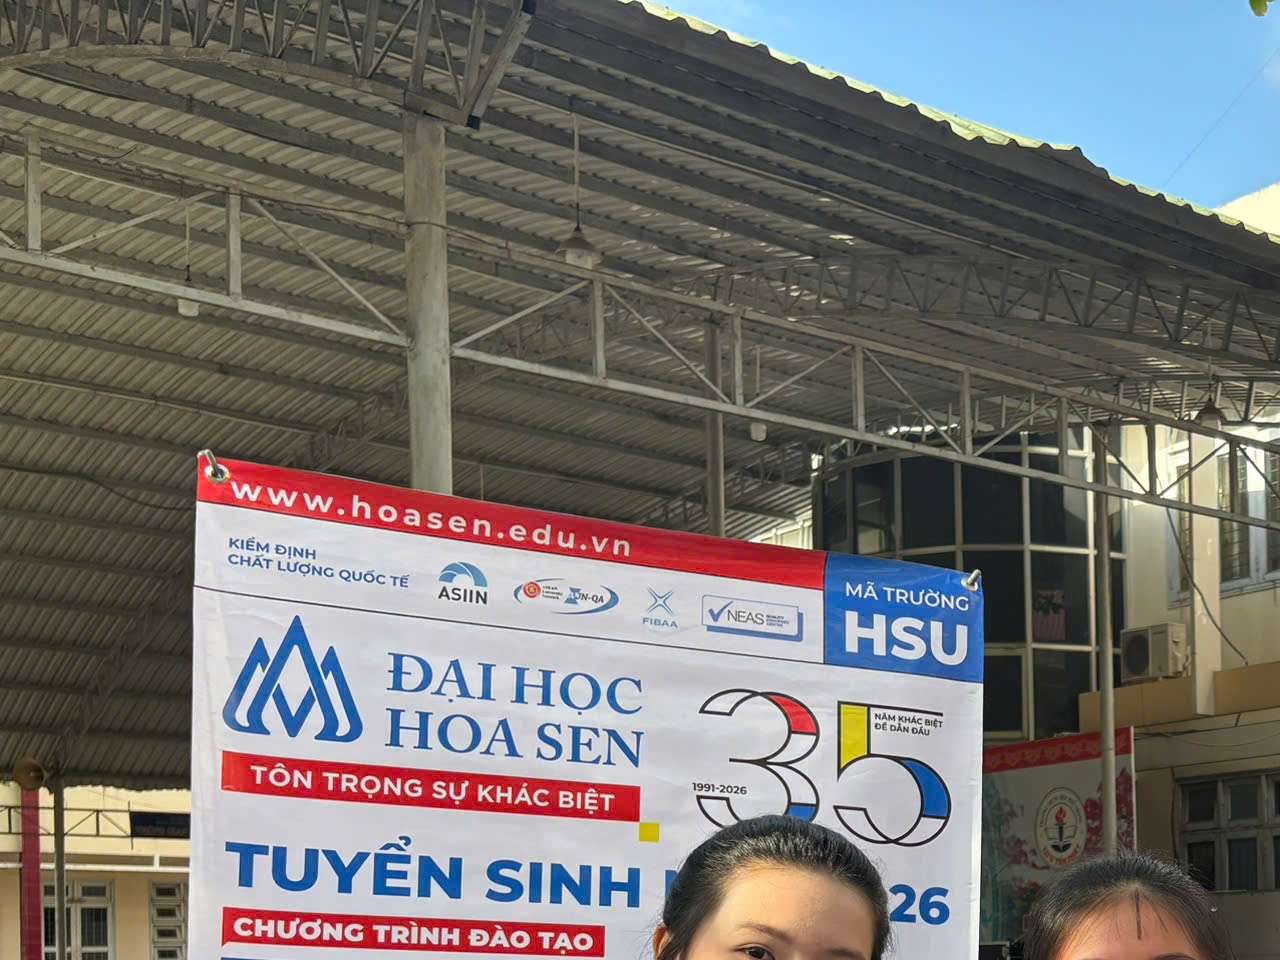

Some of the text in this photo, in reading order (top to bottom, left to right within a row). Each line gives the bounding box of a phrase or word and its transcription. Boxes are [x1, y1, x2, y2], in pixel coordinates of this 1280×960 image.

[230, 480, 631, 557] www.hoasen.edu.vn
[228, 536, 317, 560] KIỂM ĐỊNH
[227, 551, 409, 588] CHẤT LƯỢNG QUỐC TẾ
[438, 585, 488, 605] ASIIN
[845, 582, 969, 612] MÃ TRƯỜNG
[642, 617, 679, 629] FIBAA
[727, 609, 764, 625] NEAS
[844, 610, 969, 666] HSU
[386, 652, 643, 716] ĐẠI HỌC
[385, 707, 645, 769] HOA SEN
[898, 715, 923, 725] KHÁC
[250, 763, 615, 814] TÔN TRỌNG SỰ KHÁC BIỆT
[692, 782, 748, 796] 1991-2026
[225, 835, 640, 908] TUYỂN SINH
[889, 884, 950, 926] 26
[233, 916, 594, 955] CHƯƠNG TRÌNH ĐÀO TẠO
